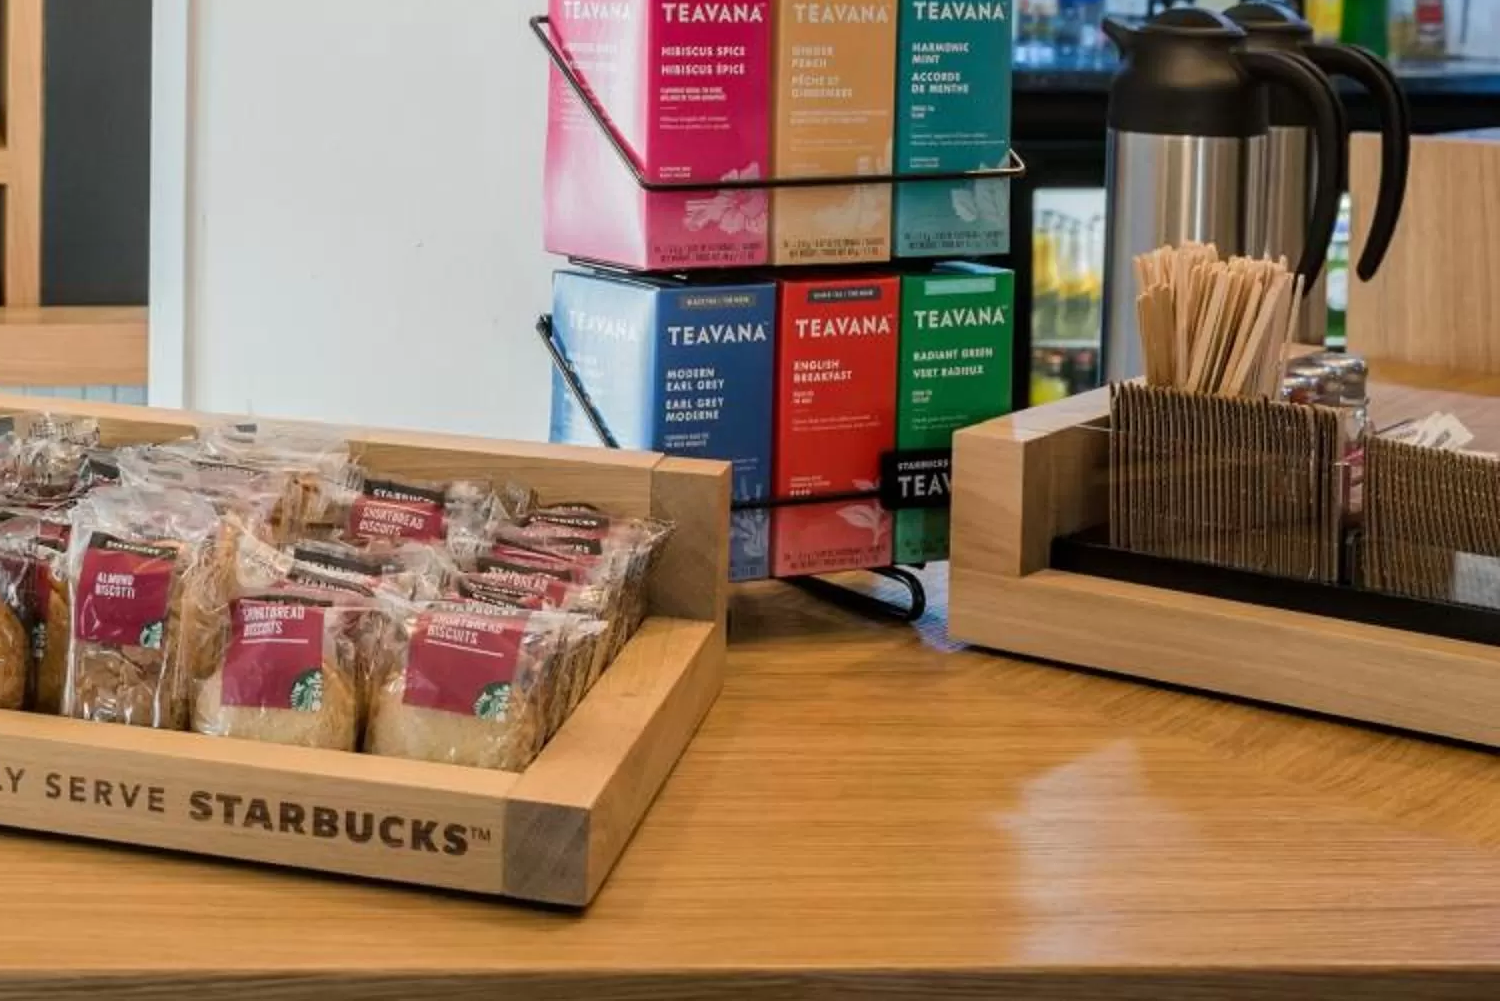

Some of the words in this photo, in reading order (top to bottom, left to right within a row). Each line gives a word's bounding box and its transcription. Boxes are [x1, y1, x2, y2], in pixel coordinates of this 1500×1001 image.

[563, 0, 630, 20] TEAVANA
[661, 2, 763, 23] TEAVANA
[793, 3, 888, 24] TEAVANA
[913, 1, 1005, 21] TEAVANA
[661, 46, 713, 57] HIBISCUS
[716, 46, 745, 57] SPICE
[911, 42, 969, 53] HARMONIC
[911, 54, 941, 64] MINT
[661, 64, 713, 76] HIBISCUS
[911, 84, 925, 94] DE
[930, 83, 969, 94] MENTHE
[913, 306, 1006, 329] TEAVANA
[795, 315, 891, 338] TEAVANA
[667, 323, 767, 347] TEAVANA
[913, 349, 958, 361] RADIANT
[961, 347, 993, 359] GREEN
[793, 359, 840, 371] ENGLISH
[666, 367, 715, 379] MODERN
[793, 370, 852, 383] BREAKFAST
[666, 380, 693, 392] EARL
[697, 379, 725, 391] GREY
[665, 399, 693, 410] EARL
[697, 397, 725, 409] GREY
[665, 410, 720, 422] MODERNE
[898, 459, 948, 471] STARBUCKS
[362, 506, 425, 530] SHORTBREAD
[359, 519, 402, 536] BISCUITS
[96, 572, 135, 586] ALMOND
[242, 605, 305, 621] SHORTBREAD
[243, 620, 283, 638] BISCUITS
[427, 624, 479, 645] BISCUITS
[45, 772, 165, 813] SERVE
